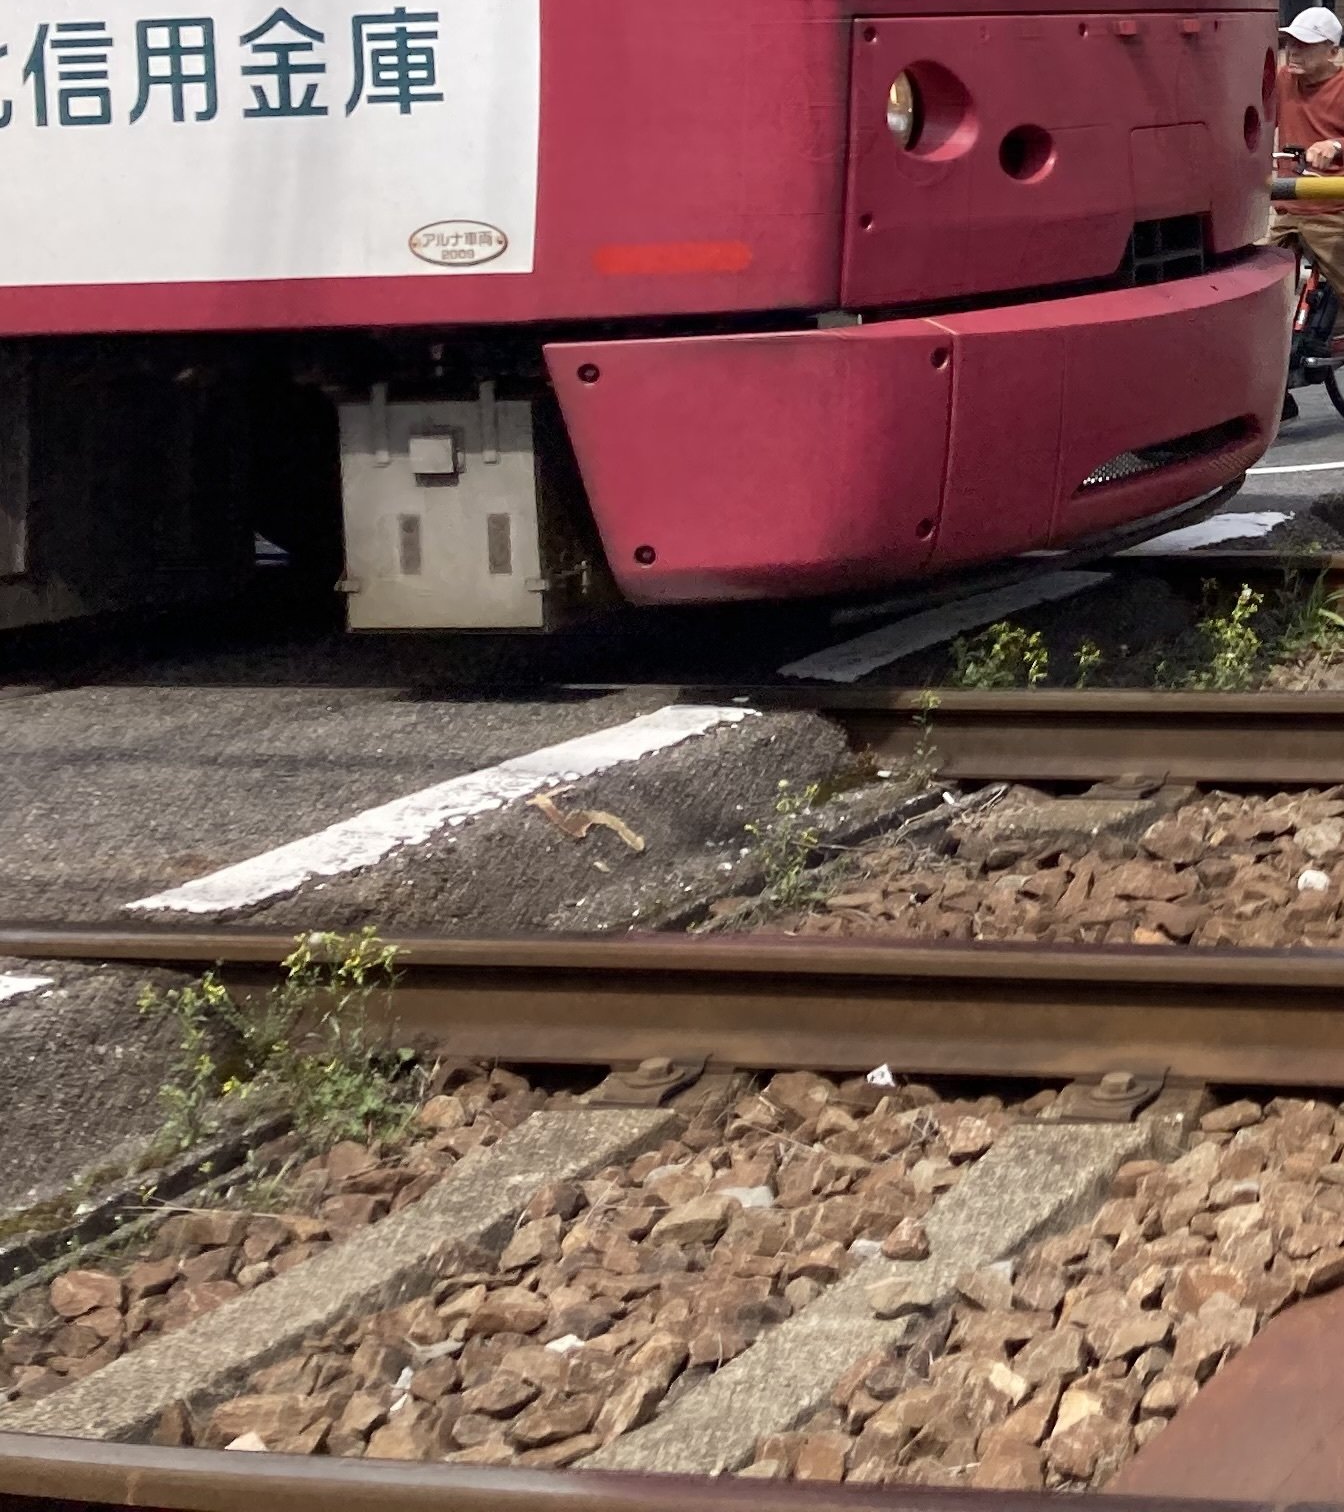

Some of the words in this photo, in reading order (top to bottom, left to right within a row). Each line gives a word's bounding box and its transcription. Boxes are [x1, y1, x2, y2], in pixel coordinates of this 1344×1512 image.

[0, 7, 445, 128] 信用金庫
[422, 230, 493, 248] アルナ車両
